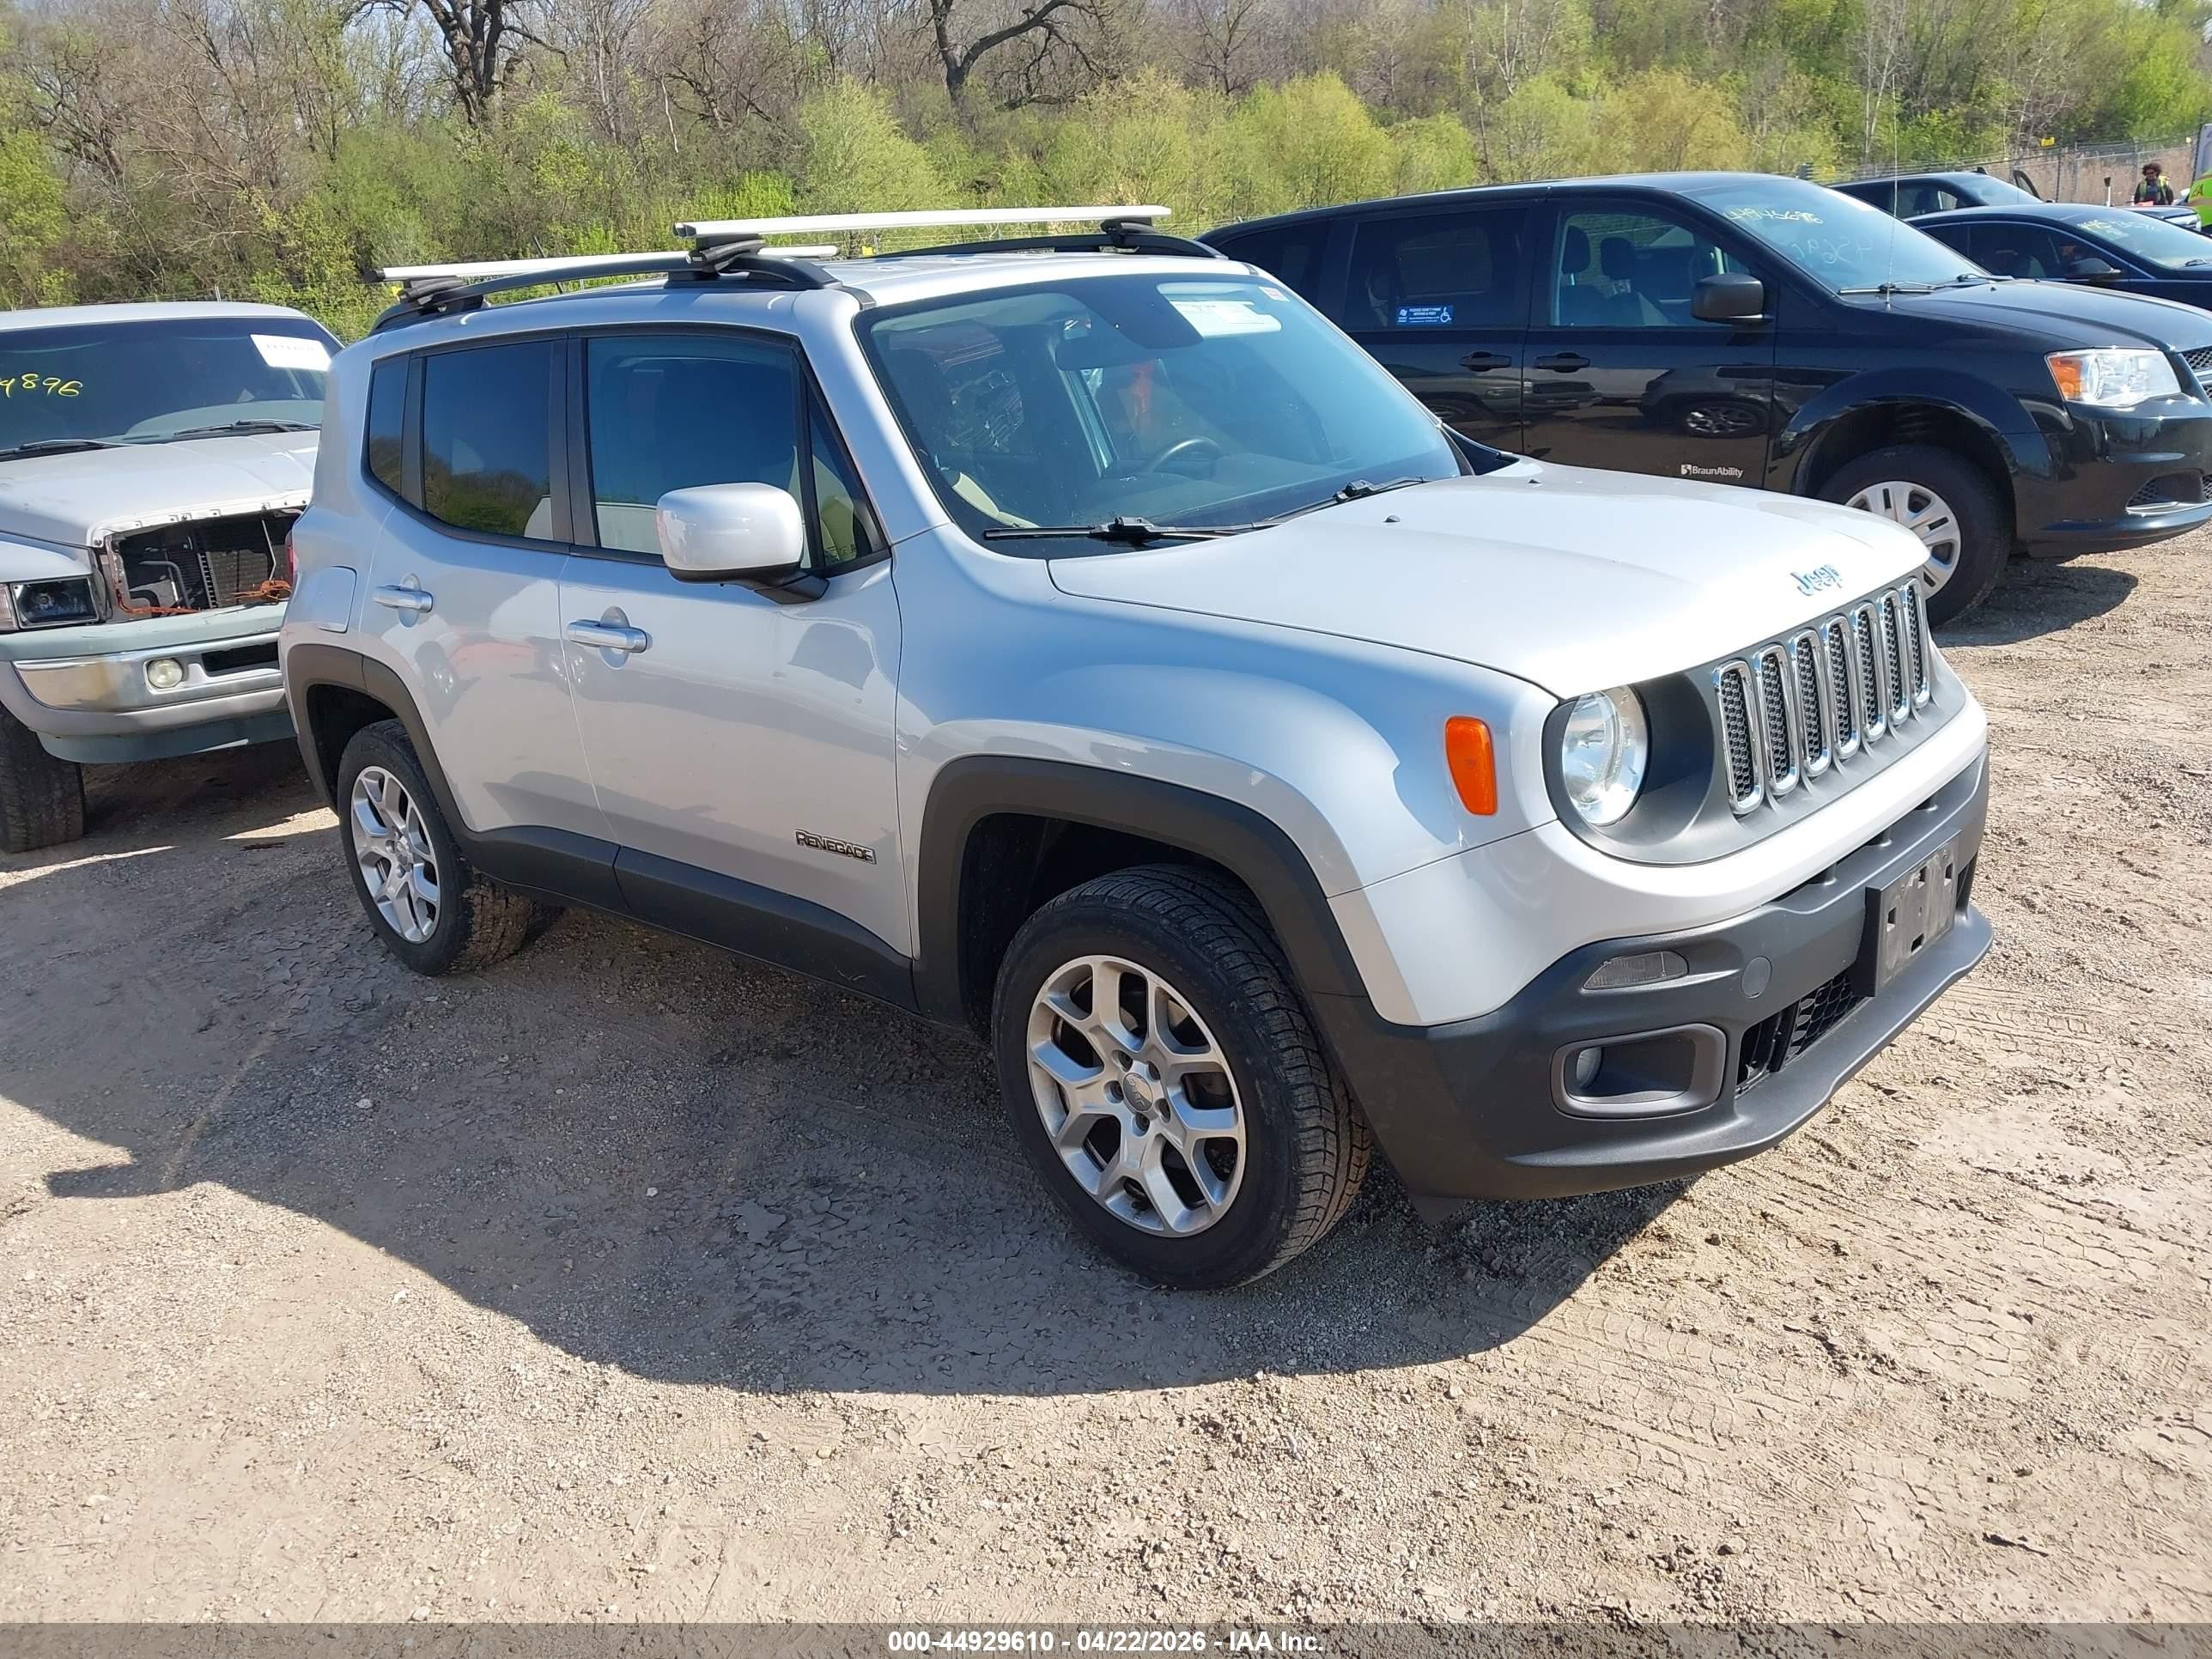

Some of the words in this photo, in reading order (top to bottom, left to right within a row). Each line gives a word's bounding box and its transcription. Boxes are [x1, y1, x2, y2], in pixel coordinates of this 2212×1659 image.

[1692, 465, 1744, 478] BraunAbility
[1790, 564, 1843, 597] Jeep
[794, 829, 877, 865] RENEGADE
